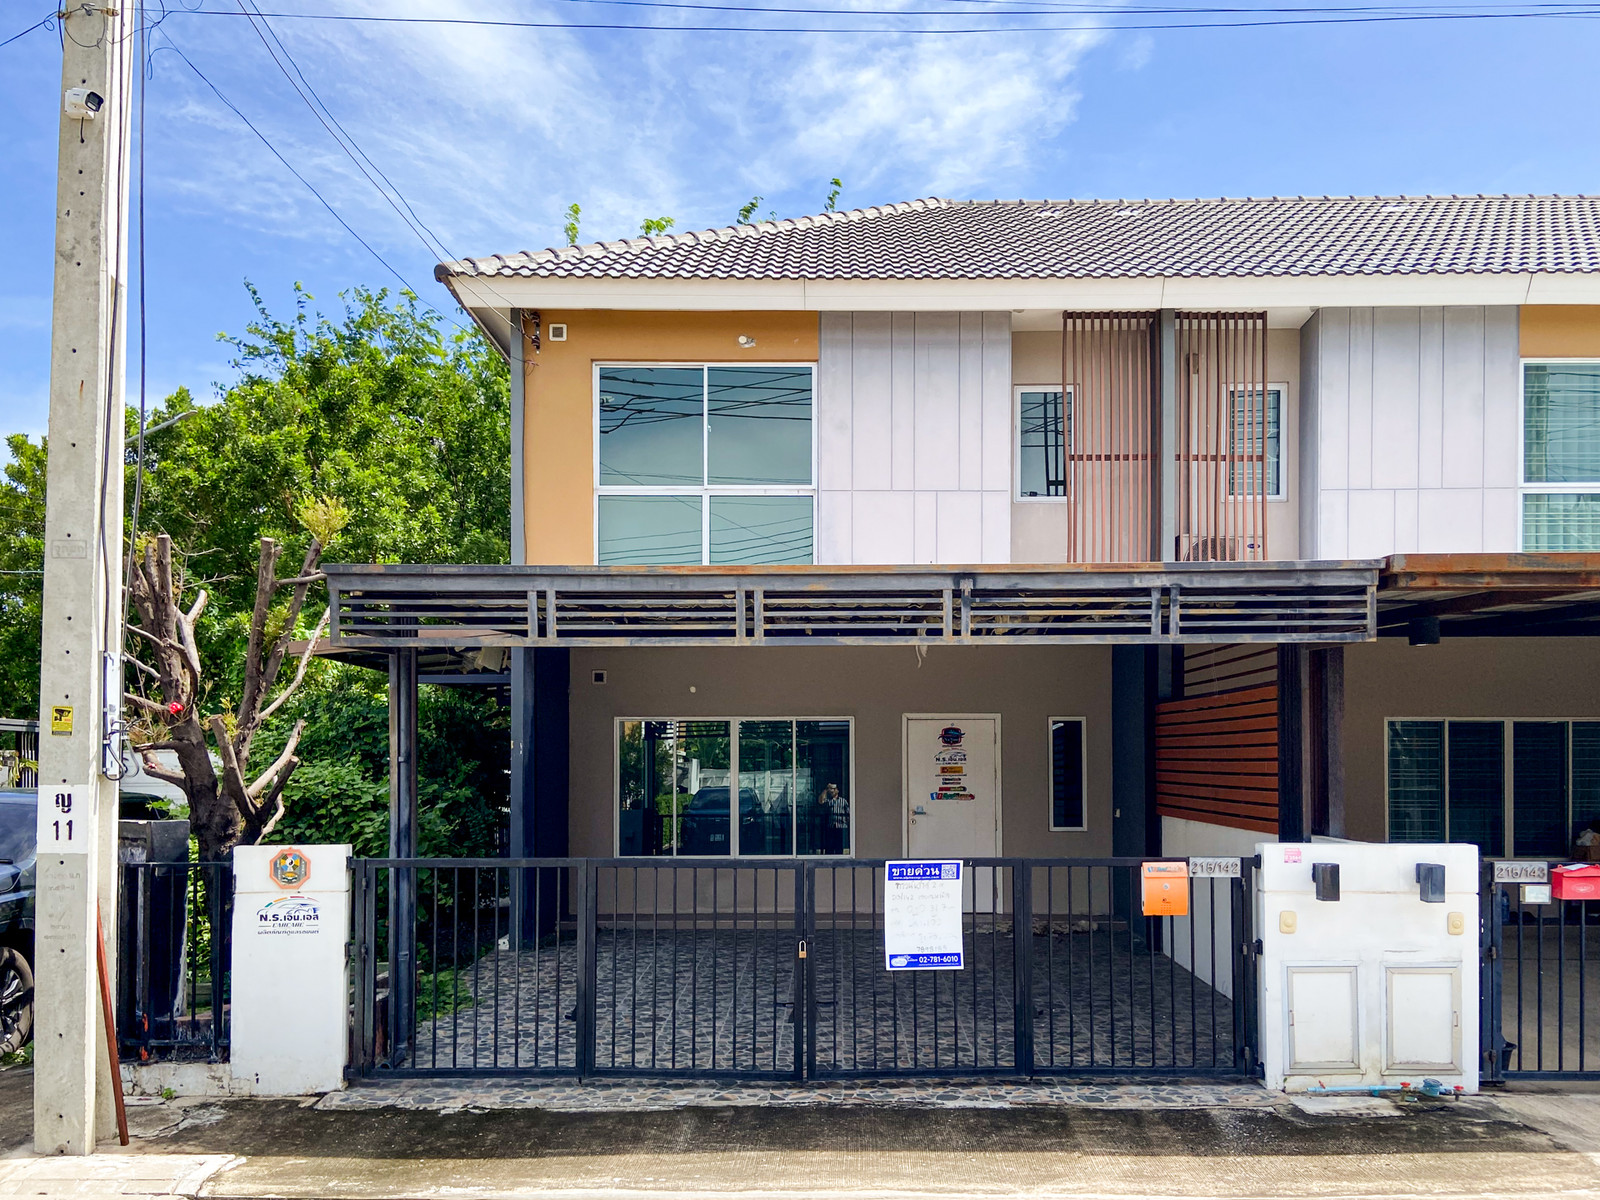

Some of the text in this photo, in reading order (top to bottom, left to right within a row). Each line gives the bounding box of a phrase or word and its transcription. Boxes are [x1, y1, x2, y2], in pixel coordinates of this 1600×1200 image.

[55, 793, 72, 813] ญ
[52, 820, 73, 841] 11
[891, 864, 940, 876] ขายด่วน
[1191, 861, 1239, 874] 215/142
[1496, 865, 1546, 879] 215/143
